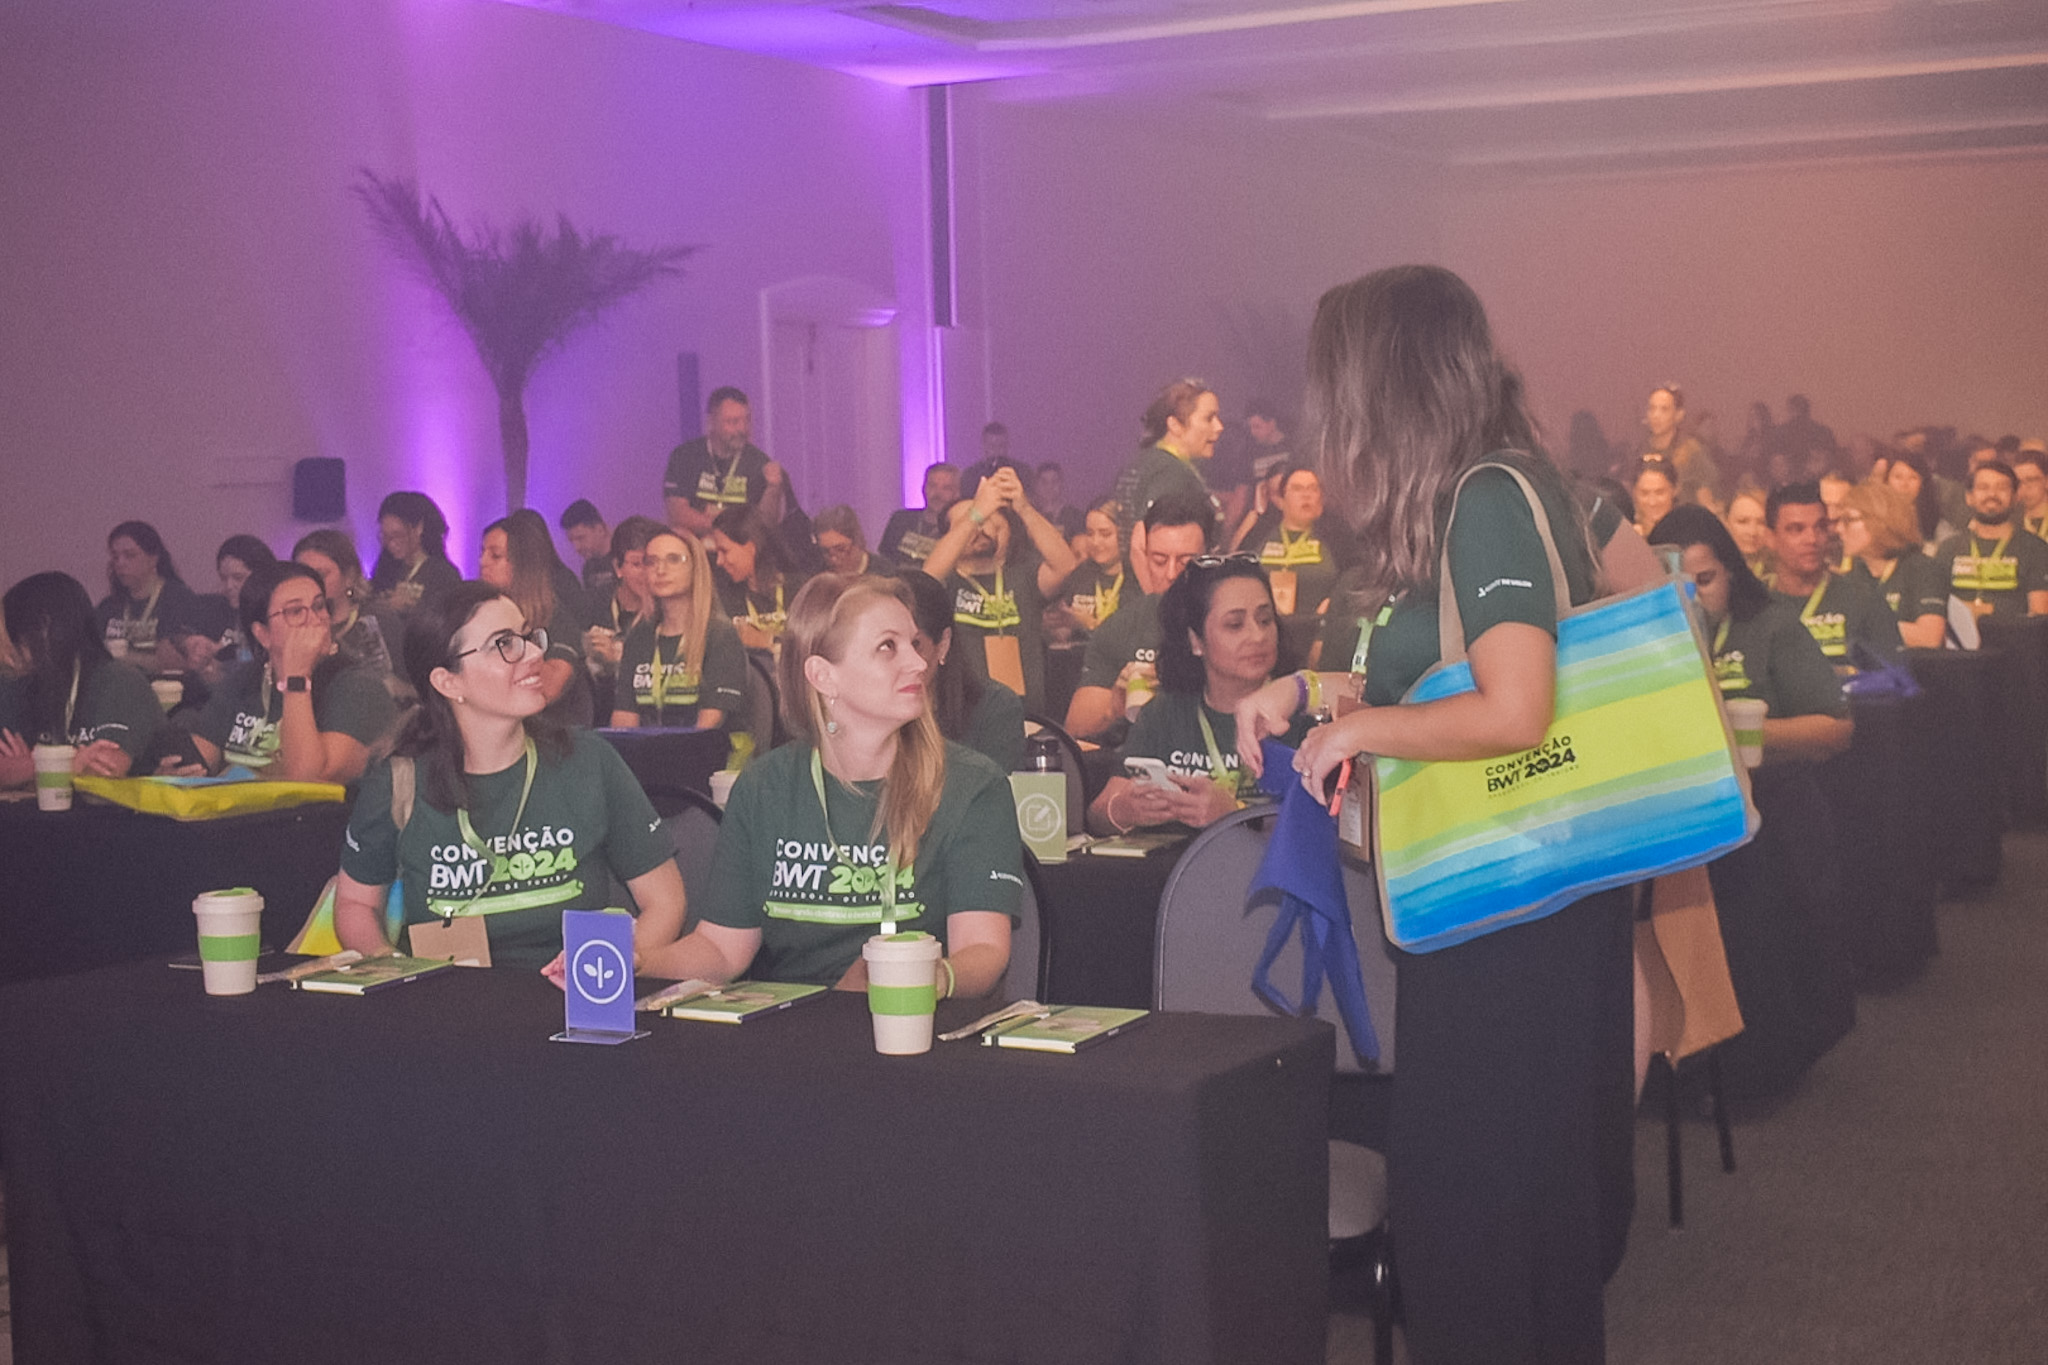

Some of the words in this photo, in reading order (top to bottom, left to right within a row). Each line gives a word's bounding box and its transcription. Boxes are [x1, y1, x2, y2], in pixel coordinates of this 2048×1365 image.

[1487, 768, 1521, 792] BWT
[1524, 747, 1576, 779] 2024
[430, 825, 575, 863] CONENÇÃO
[776, 838, 890, 867] CONVENÇ
[430, 859, 488, 890] BWT
[491, 847, 578, 882] 2024
[773, 860, 828, 890] BWT
